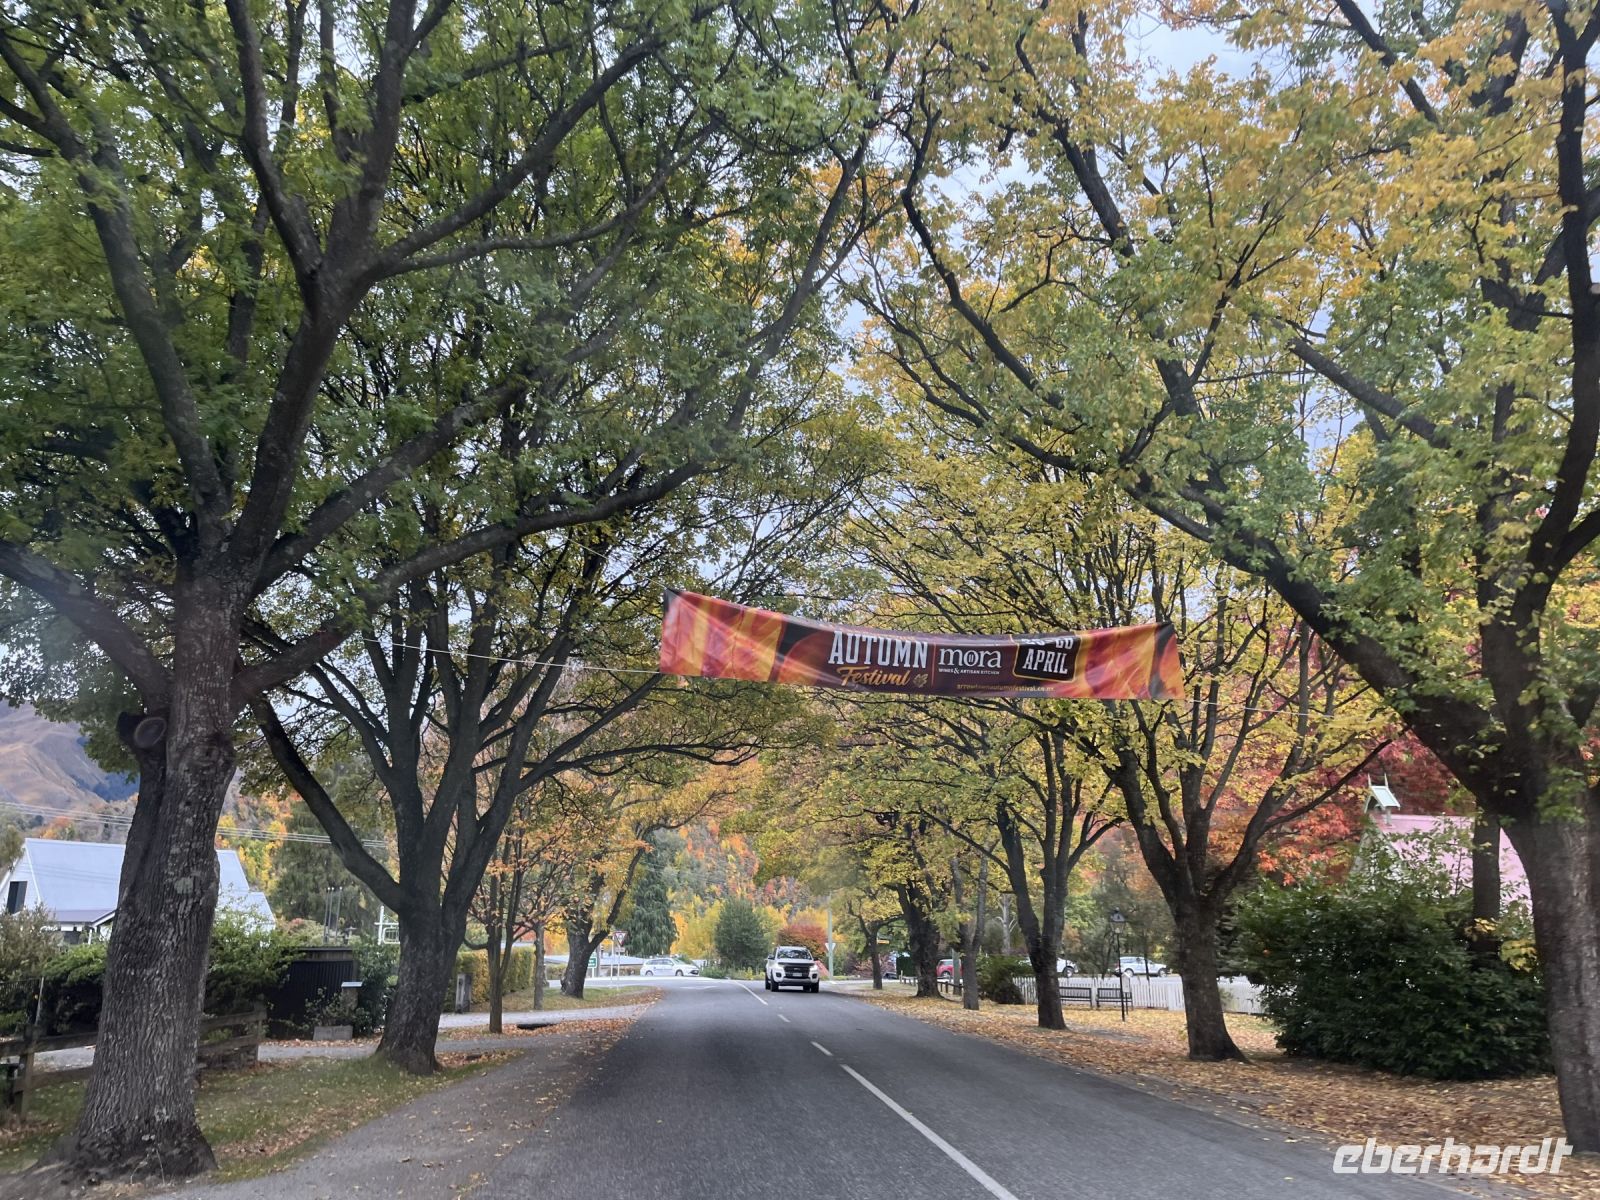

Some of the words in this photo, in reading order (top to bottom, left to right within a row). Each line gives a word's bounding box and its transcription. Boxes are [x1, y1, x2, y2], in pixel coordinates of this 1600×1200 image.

[828, 630, 928, 669] AUTUMN
[938, 648, 1002, 669] mora
[1022, 648, 1068, 675] APRIL
[836, 665, 911, 687] Festival
